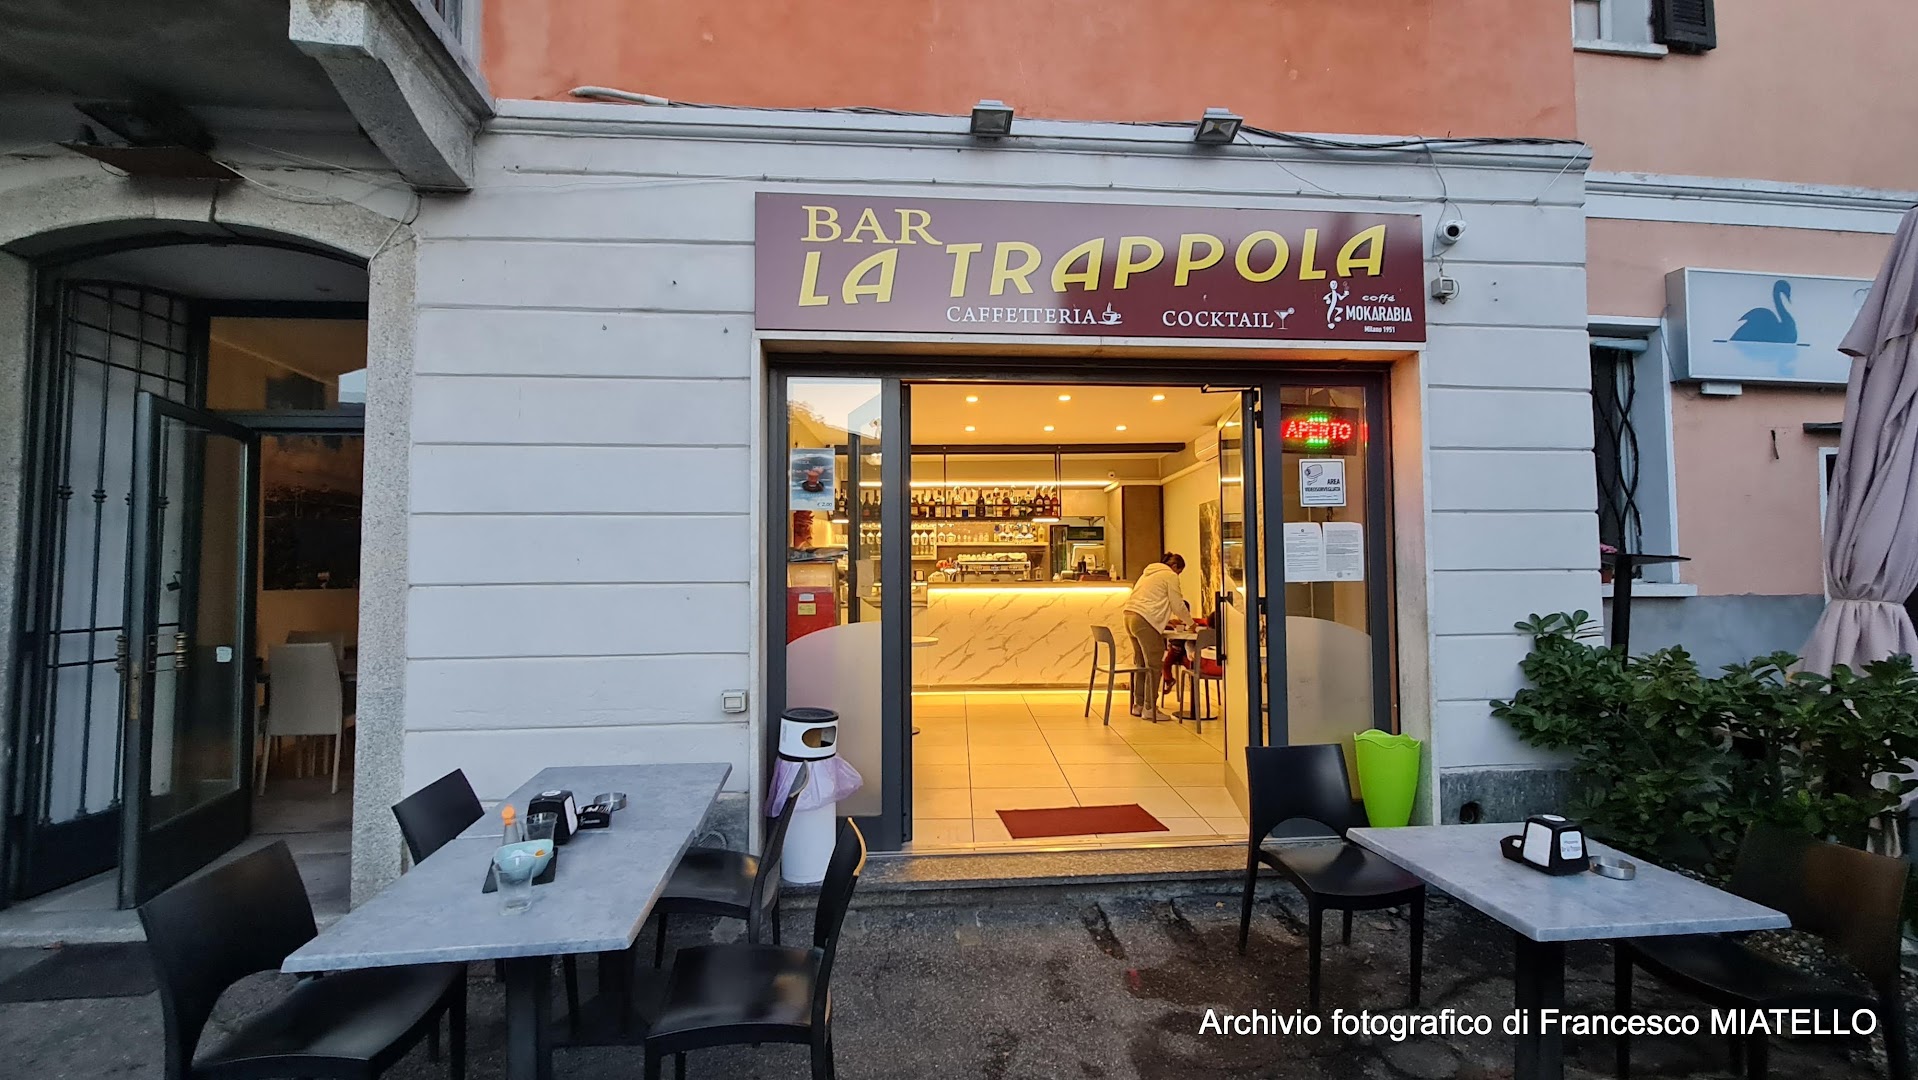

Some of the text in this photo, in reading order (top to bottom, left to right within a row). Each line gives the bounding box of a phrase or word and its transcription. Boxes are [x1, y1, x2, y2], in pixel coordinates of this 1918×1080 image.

[801, 205, 943, 245] BAR
[799, 224, 1386, 306] LA TRAPPOLA
[946, 306, 1099, 325] CAFFETTERIA
[1162, 310, 1274, 328] COCKTAIL
[1345, 305, 1413, 322] MOKARABIA
[1364, 325, 1382, 333] Milano
[1285, 421, 1352, 439] APERTO
